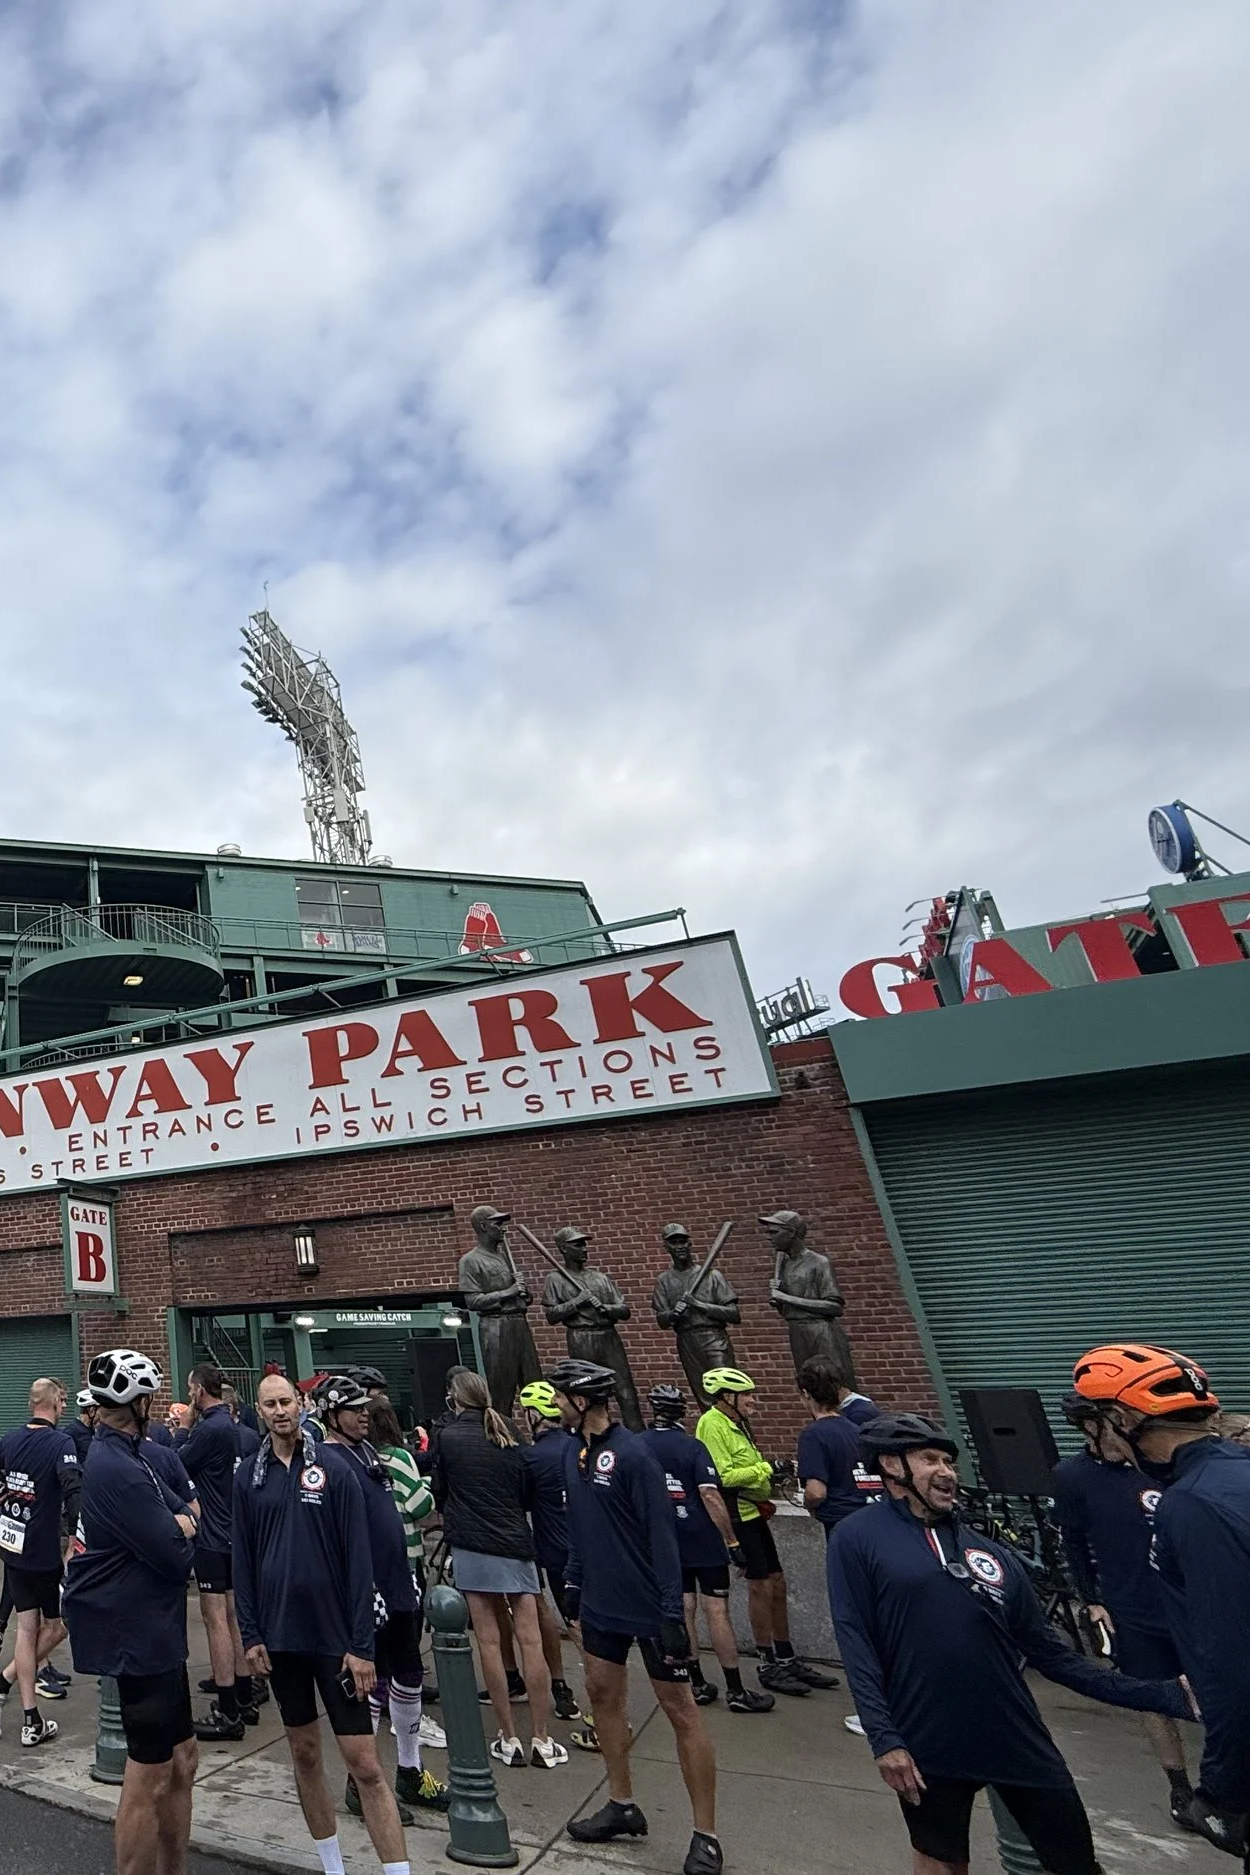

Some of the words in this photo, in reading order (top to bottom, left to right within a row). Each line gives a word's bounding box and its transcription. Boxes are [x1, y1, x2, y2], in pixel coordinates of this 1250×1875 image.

[302, 961, 713, 1089] PARK
[68, 1104, 276, 1152] ENTRANCE
[310, 1088, 392, 1117] ALL
[430, 1036, 721, 1099] SECTIONS
[296, 1102, 483, 1144] IPSWICH
[524, 1067, 726, 1114] STREET
[31, 1148, 154, 1179] STREET
[70, 1206, 107, 1226] GATE
[75, 1231, 107, 1282] B
[336, 1313, 359, 1322] GAME
[359, 1313, 387, 1322] SAVING
[387, 1313, 412, 1322] CATCH
[2, 1529, 17, 1545] 230
